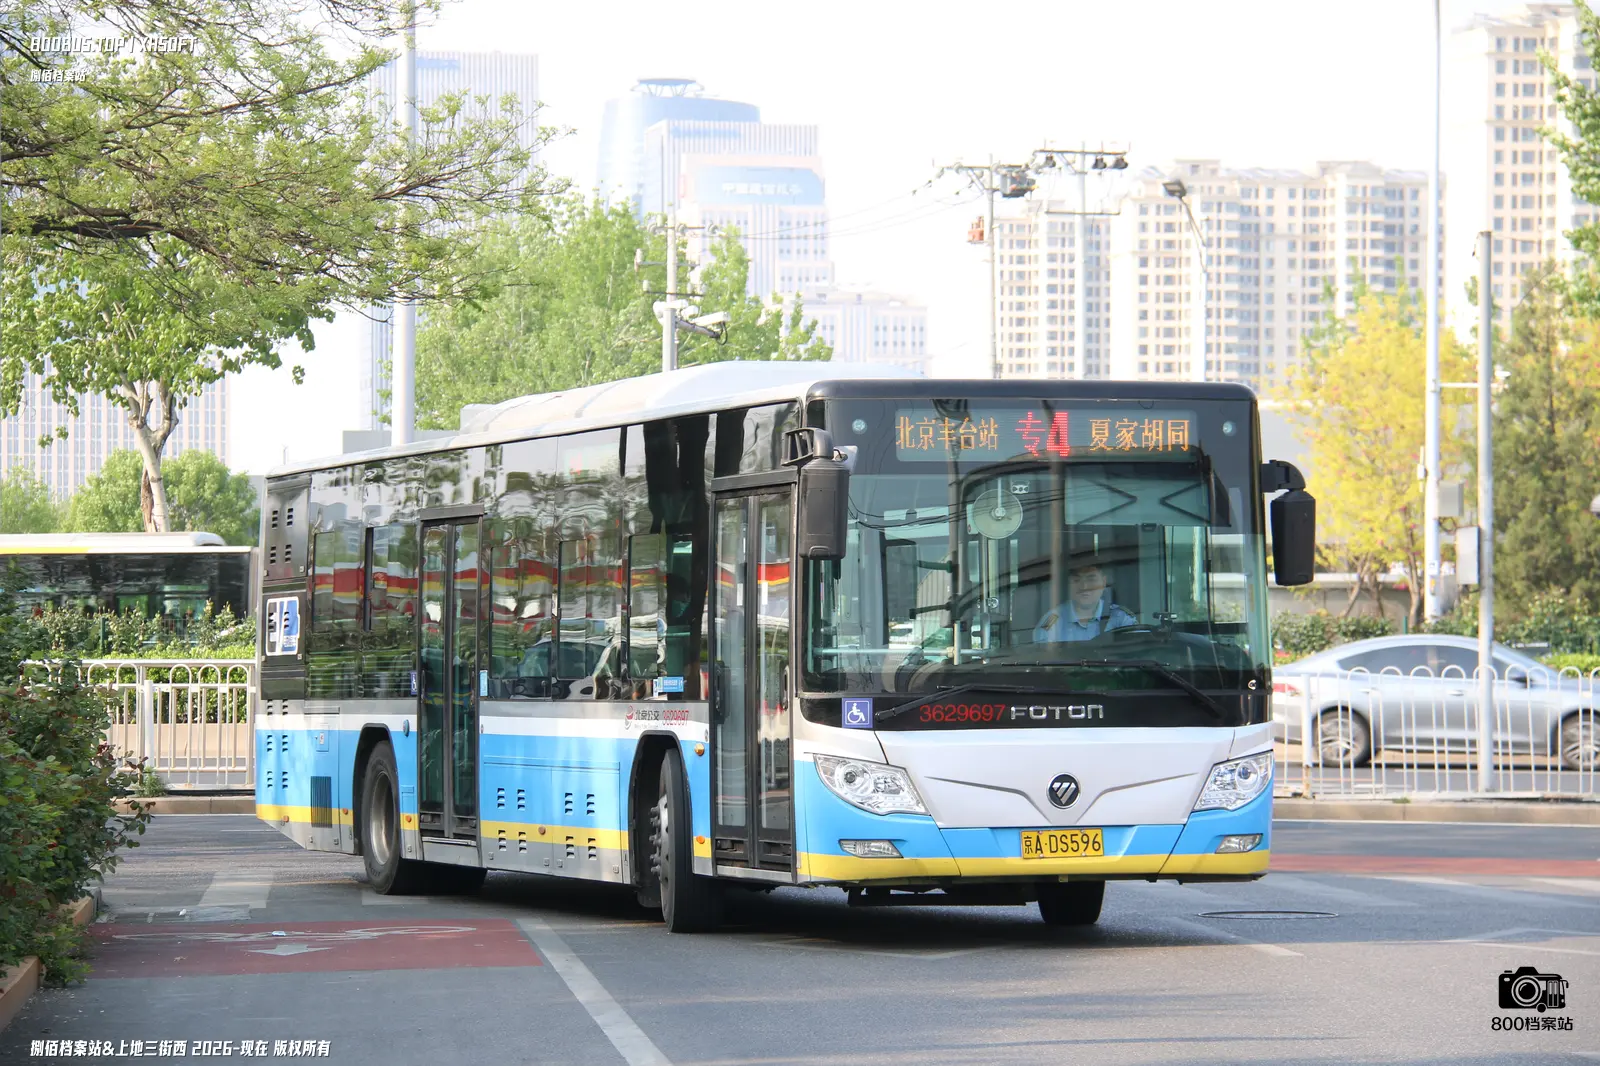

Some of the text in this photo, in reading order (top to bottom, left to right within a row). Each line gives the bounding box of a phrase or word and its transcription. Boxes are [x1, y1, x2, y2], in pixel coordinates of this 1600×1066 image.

[895, 411, 1190, 457] 北京丰台站 专4 夏家胡同
[919, 704, 1006, 723] 3629697
[1010, 704, 1104, 720] FOTON
